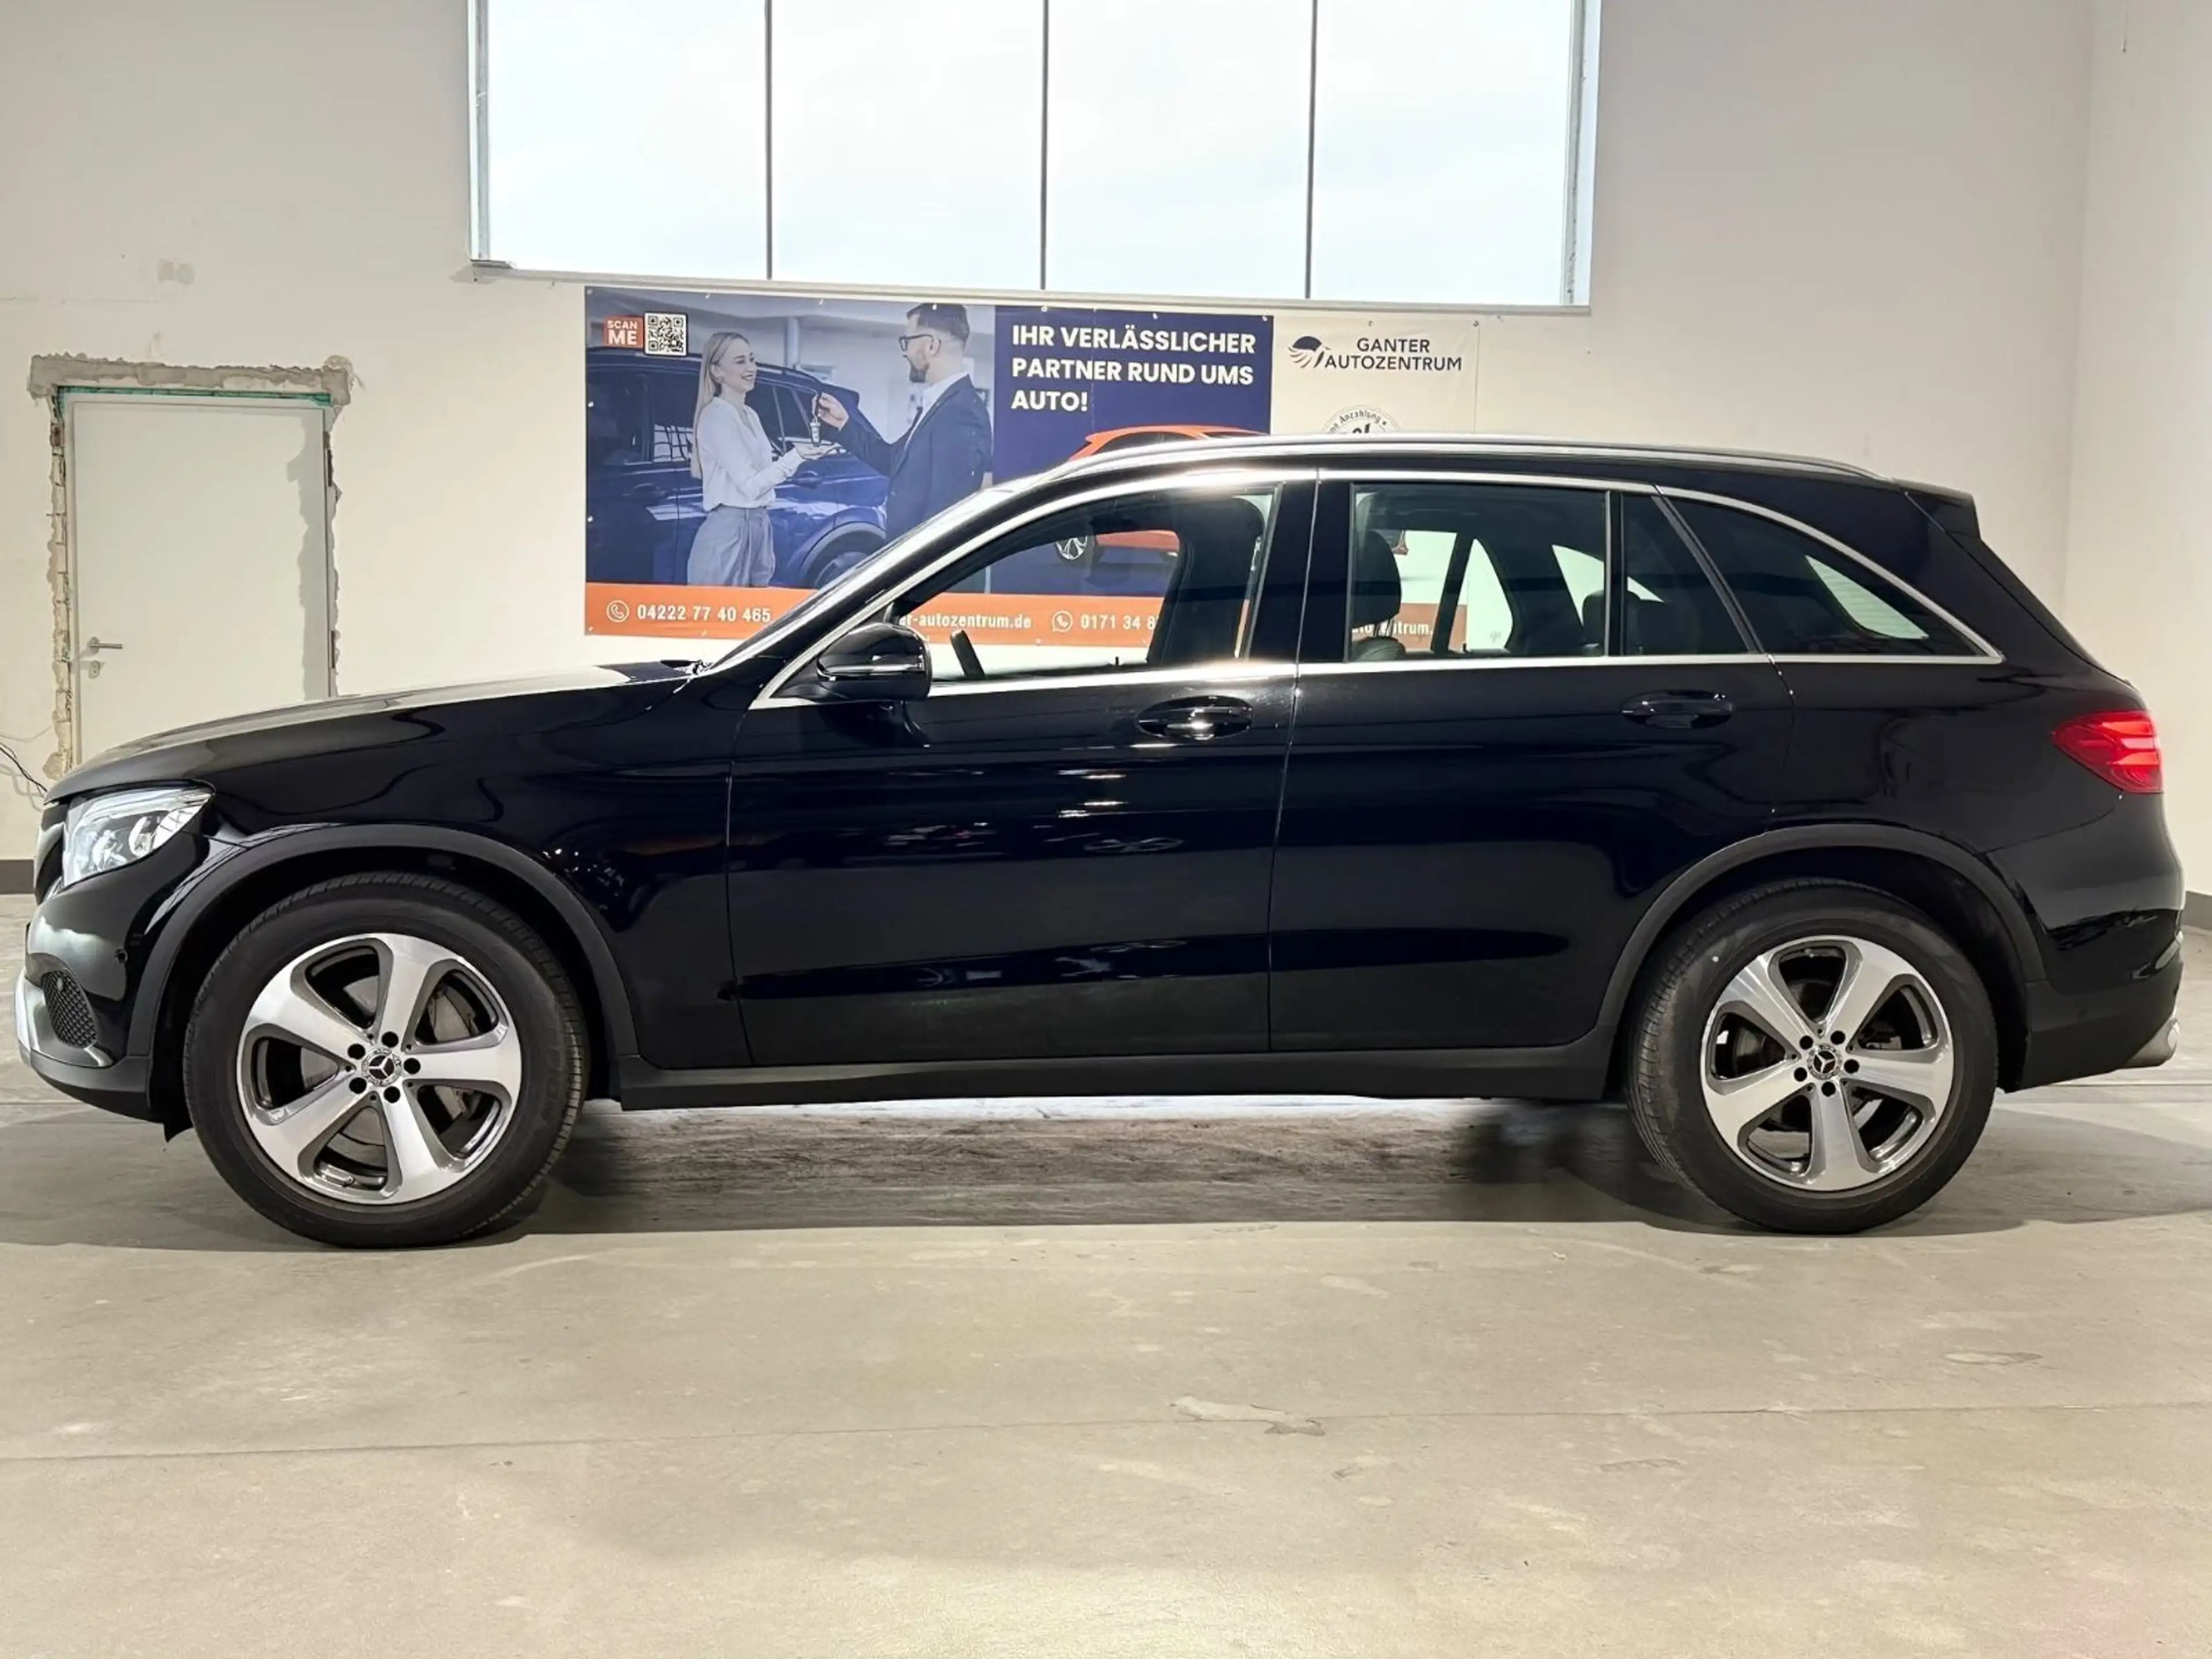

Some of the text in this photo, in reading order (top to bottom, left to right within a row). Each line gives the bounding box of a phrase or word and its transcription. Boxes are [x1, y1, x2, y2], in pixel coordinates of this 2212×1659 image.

[607, 320, 638, 329] SCAN
[608, 329, 637, 345] ME
[1013, 324, 1256, 353] IHR VERLÄSSLICHER
[1357, 338, 1430, 353] GANTER
[1324, 355, 1462, 370] AUTOZENTRUM
[1012, 358, 1253, 385] PARTNER RUND UMS
[1011, 389, 1088, 411] AUTO!
[637, 604, 771, 623] 04222 77 40 465
[1081, 614, 1160, 630] 0171 34 8
